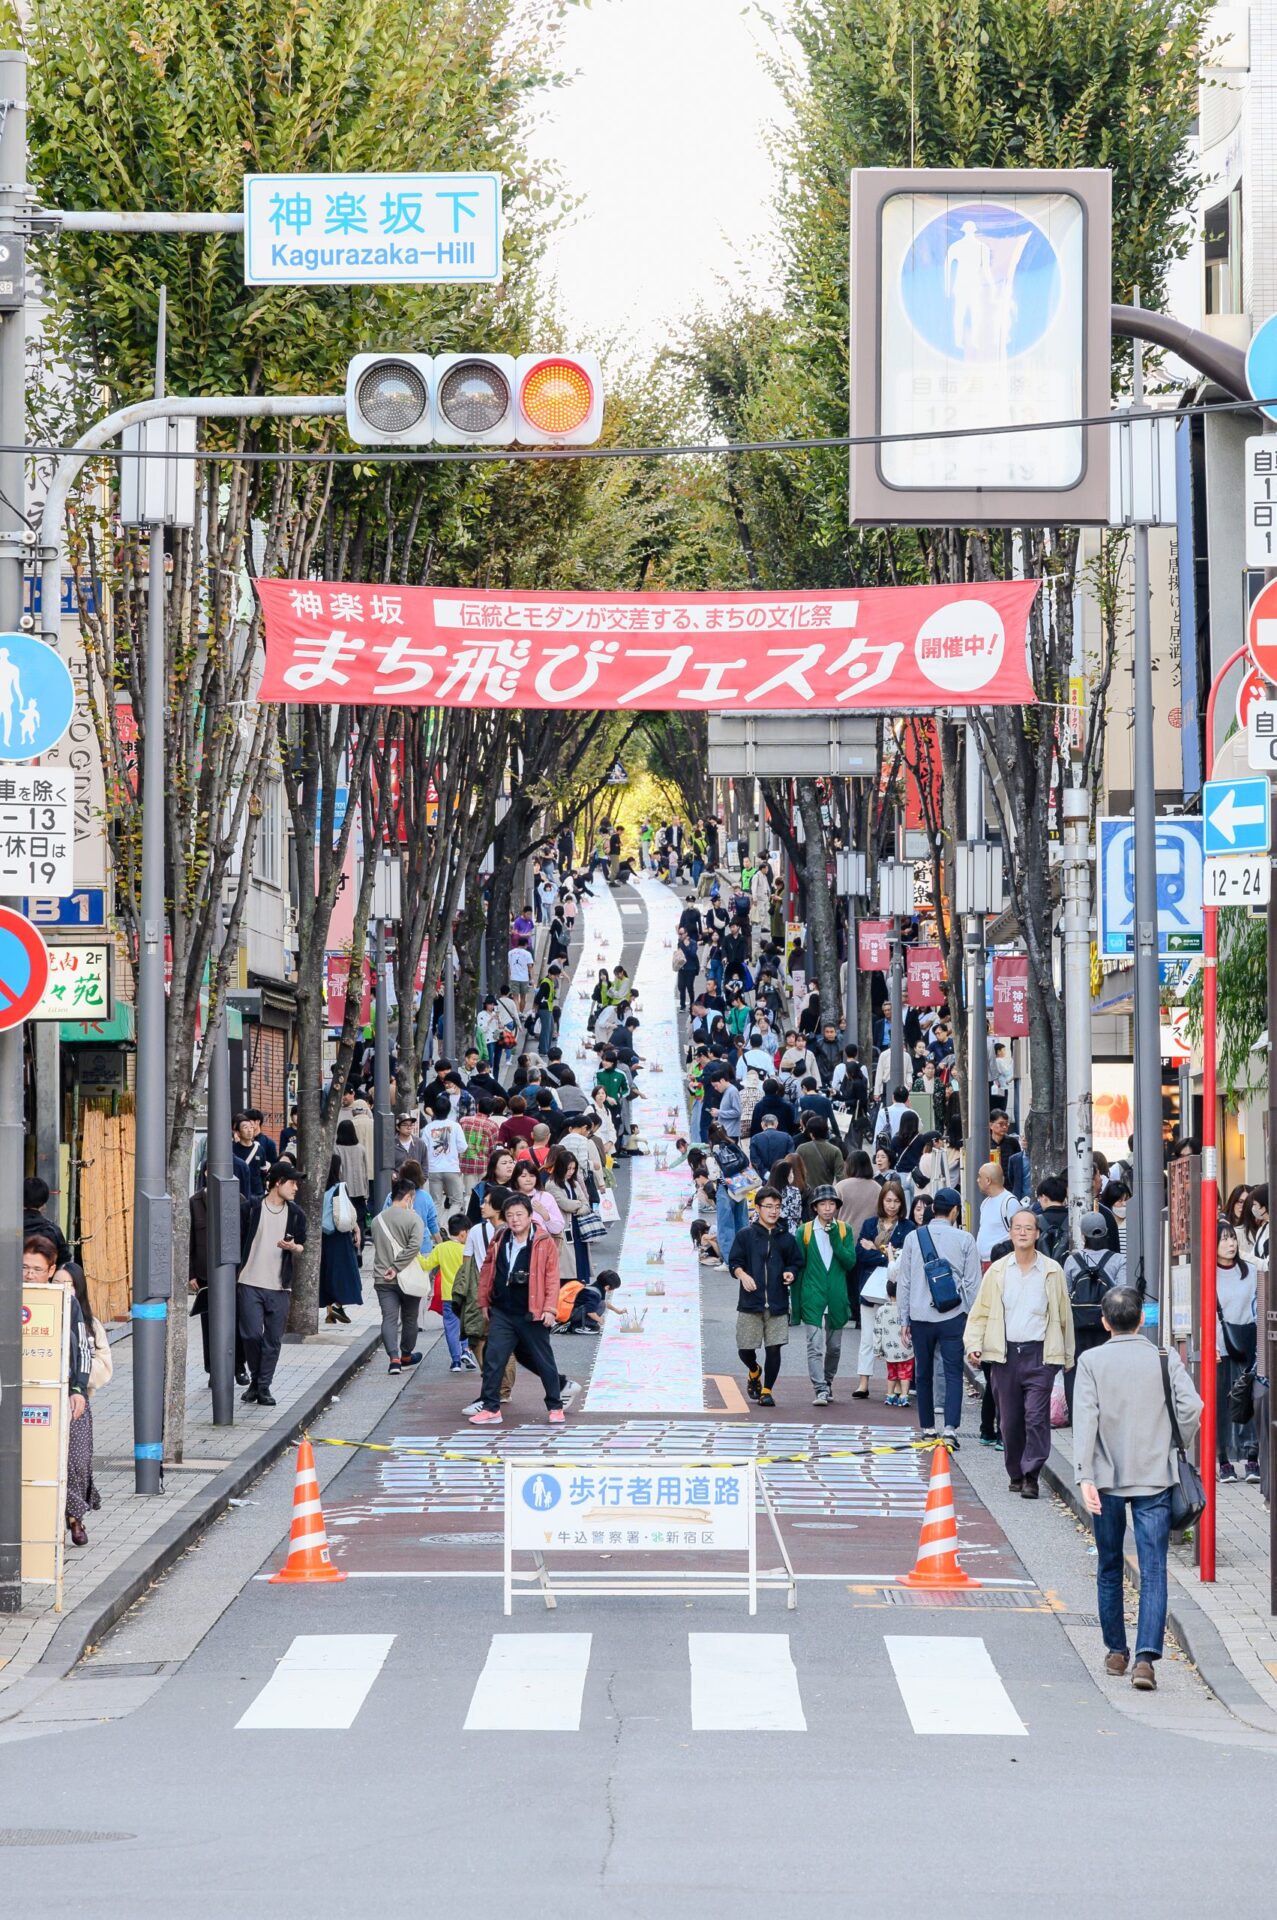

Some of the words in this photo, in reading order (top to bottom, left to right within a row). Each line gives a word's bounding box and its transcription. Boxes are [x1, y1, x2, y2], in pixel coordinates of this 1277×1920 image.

[268, 191, 480, 236] 神楽坂下
[271, 242, 475, 271] Kagurazaka-Hill
[1254, 450, 1277, 472] 自
[290, 589, 405, 625] 神楽坂
[459, 601, 833, 631] 伝統とモダンが交差する、まちの文化祭
[920, 631, 999, 660] 開催中!
[282, 630, 905, 704] まち飛びフェスタ
[1213, 867, 1260, 896] 12-24
[28, 894, 91, 922] B1
[85, 952, 103, 965] 2F
[42, 973, 104, 1006] 々苑
[921, 972, 931, 998] 神楽坂
[1012, 990, 1024, 1025] 神楽坂
[569, 1476, 740, 1506] 歩行者用道路
